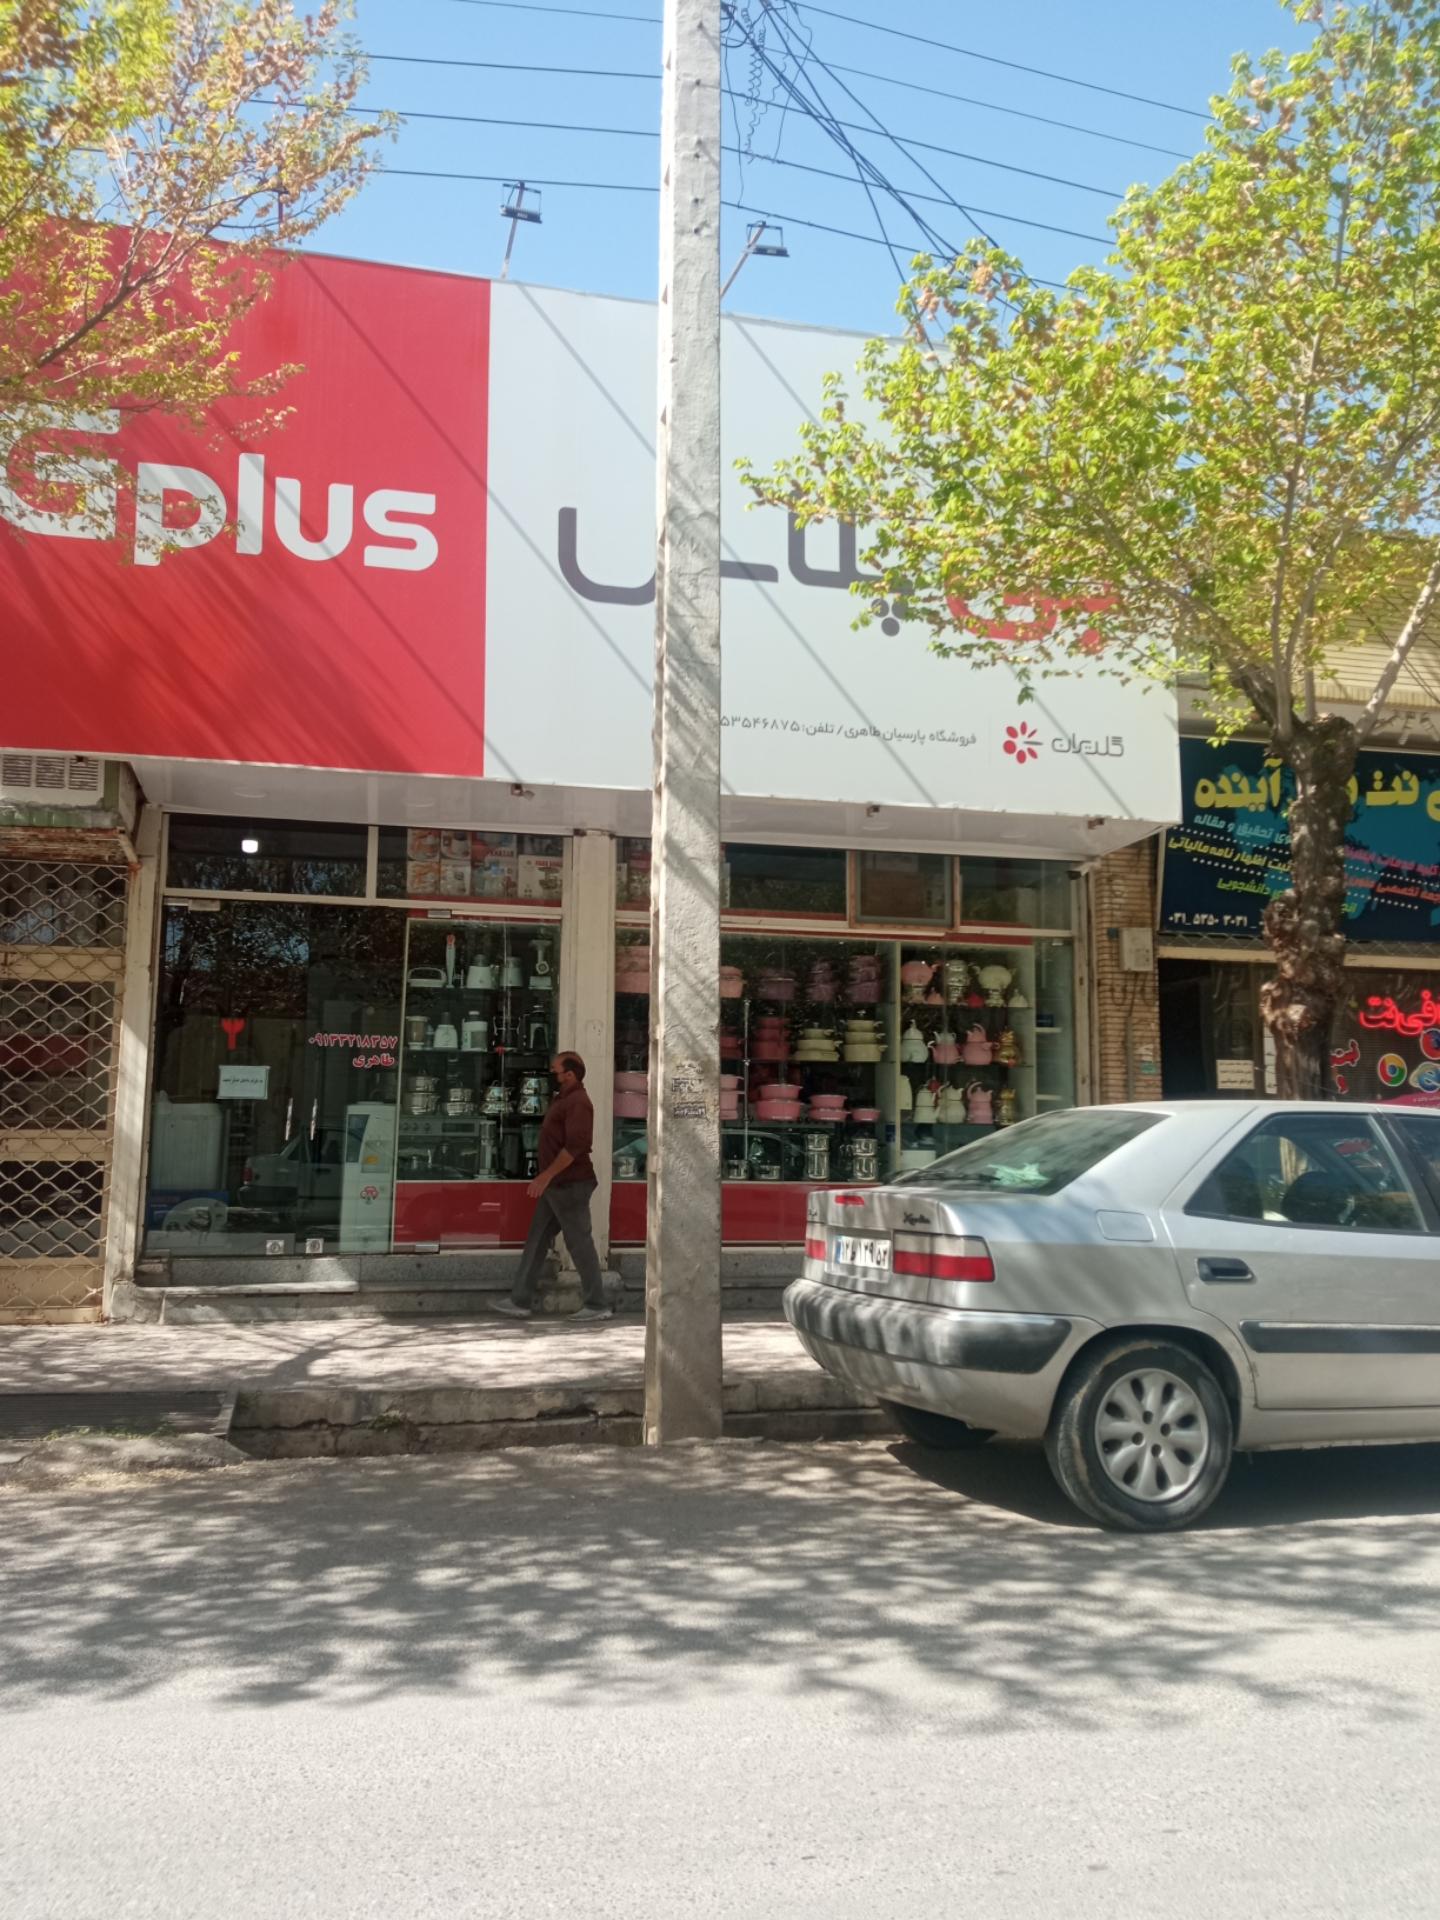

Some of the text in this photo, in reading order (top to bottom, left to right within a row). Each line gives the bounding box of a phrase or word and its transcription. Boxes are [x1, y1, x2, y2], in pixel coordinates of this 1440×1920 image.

[844, 725, 881, 739] طاهری
[882, 727, 926, 745] پارسیان
[928, 729, 977, 747] فروشگاه
[1194, 758, 1282, 812] آینده
[1366, 770, 1420, 806] نت
[1194, 813, 1226, 830] مقاله
[352, 1053, 395, 1068] طاهری
